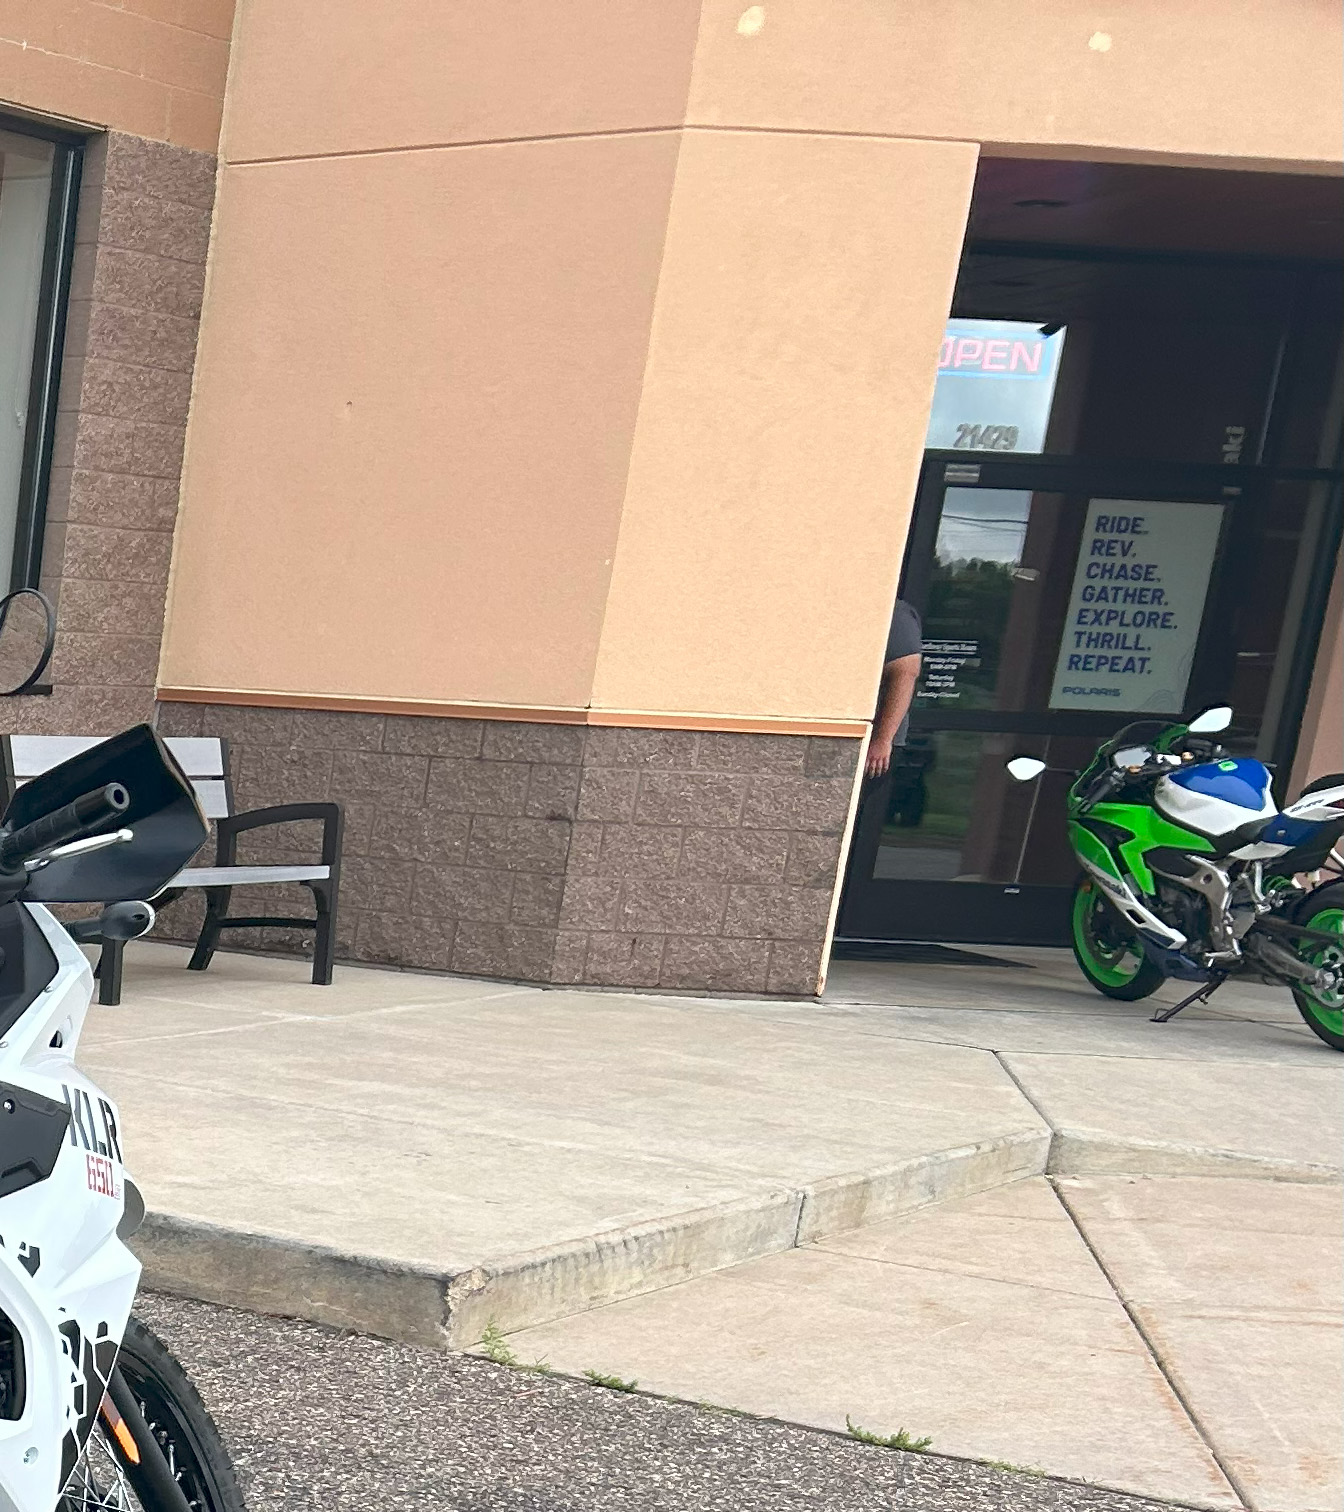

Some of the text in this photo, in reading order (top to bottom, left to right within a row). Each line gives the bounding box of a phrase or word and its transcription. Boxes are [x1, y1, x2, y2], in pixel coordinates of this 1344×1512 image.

[953, 422, 1020, 450] 21429
[1095, 515, 1149, 535] RIDE.
[1090, 538, 1137, 558] REV.
[1086, 562, 1161, 583] CHASE.
[1081, 585, 1169, 606] GATHER.
[1076, 608, 1178, 630] EXPLORE.
[1074, 631, 1151, 651] THRILL.
[1067, 654, 1152, 675] REPEAT.
[1062, 686, 1121, 697] POLARIS
[61, 1083, 123, 1165] KLR
[86, 1153, 114, 1198] 650
